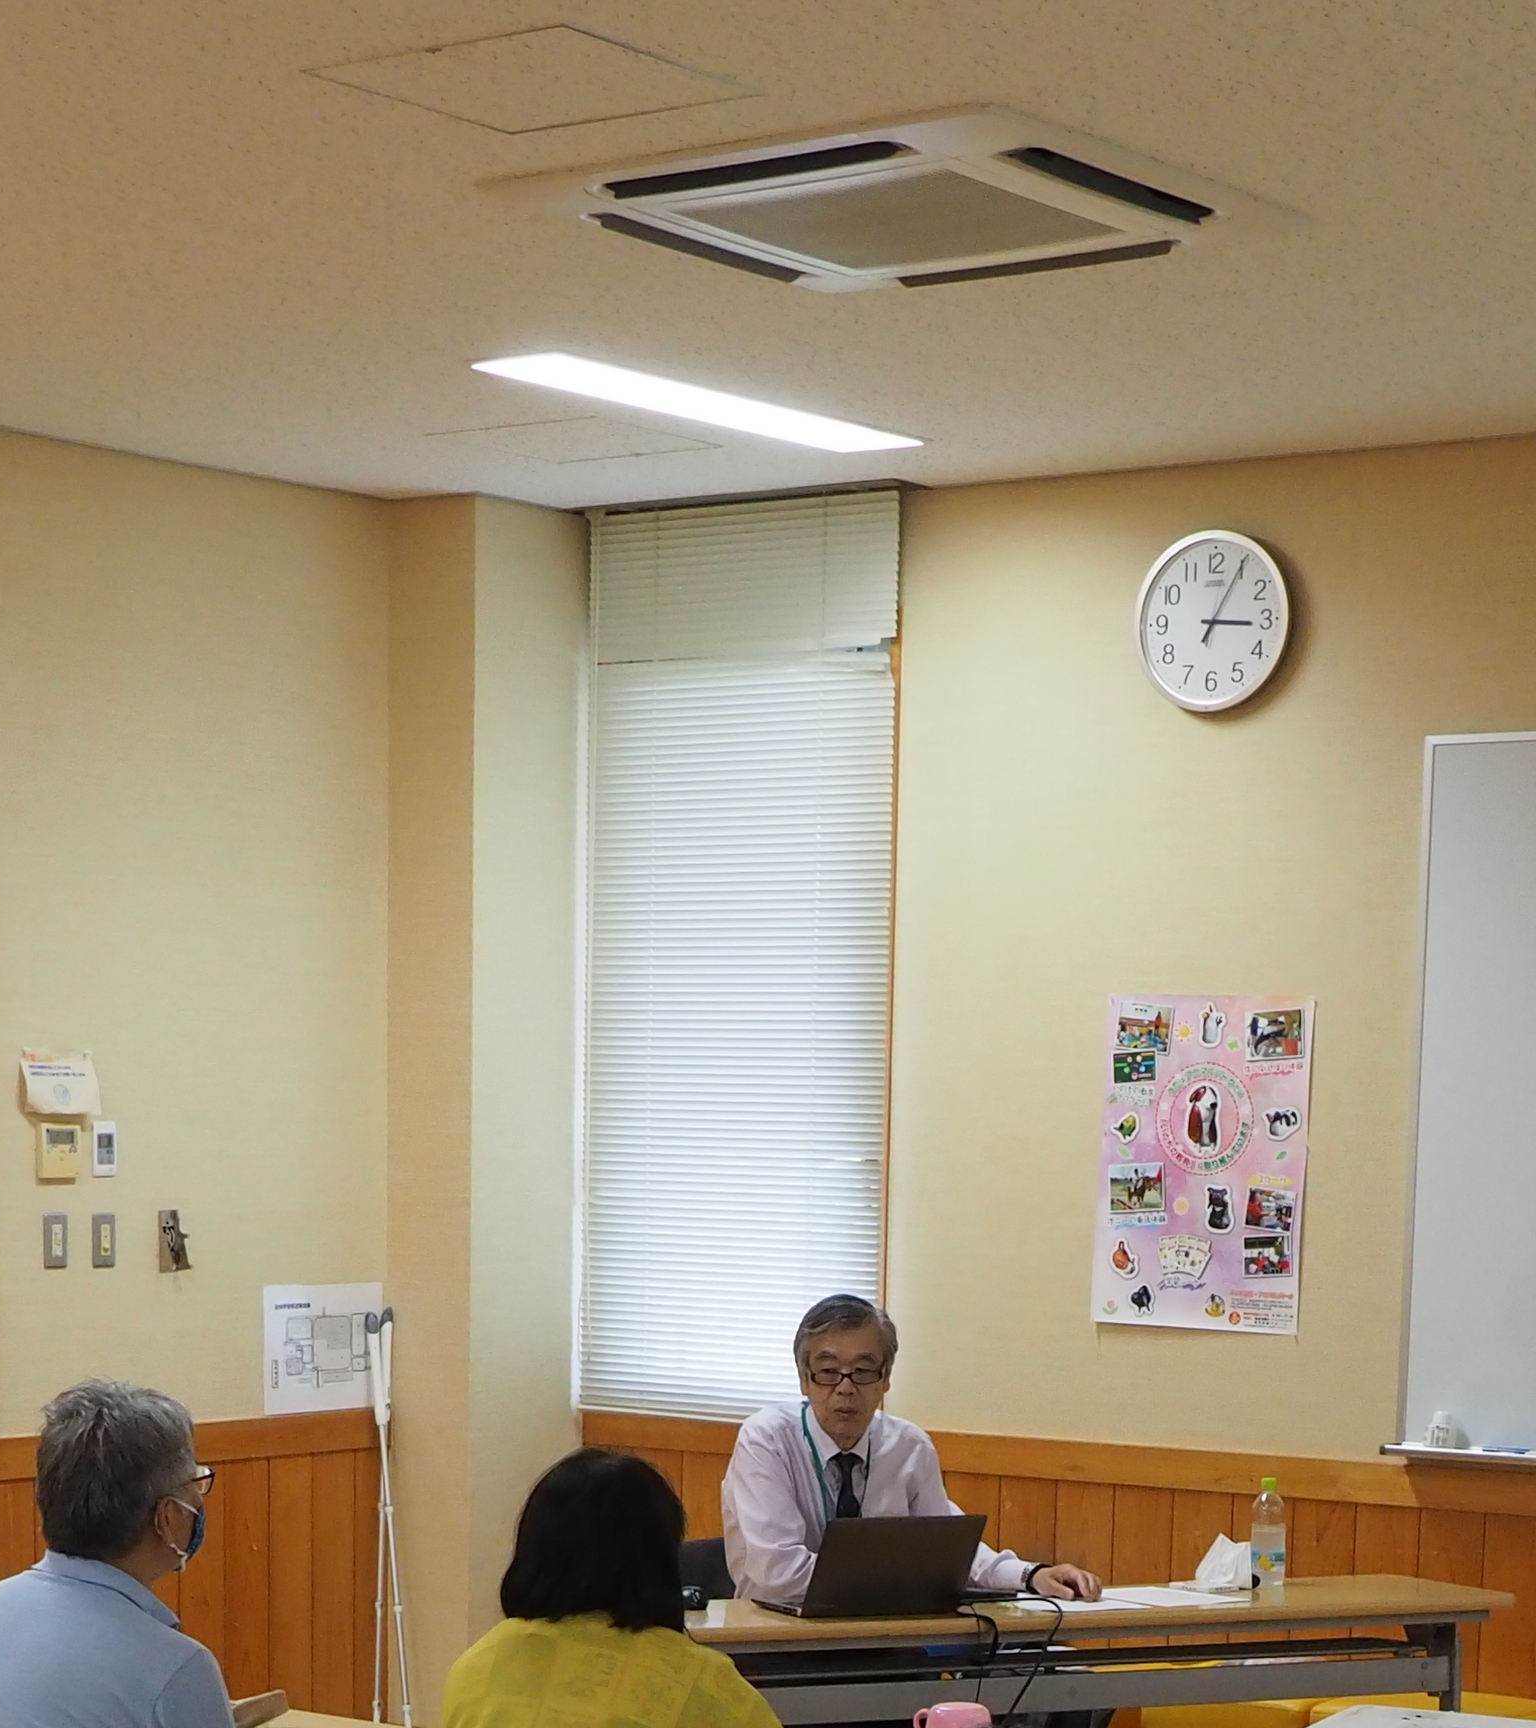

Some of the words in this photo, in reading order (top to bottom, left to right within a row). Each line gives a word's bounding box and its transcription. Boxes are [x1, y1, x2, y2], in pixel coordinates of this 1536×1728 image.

[1184, 562, 1197, 582] 11
[1208, 552, 1225, 574] 12
[1164, 584, 1181, 605] 10
[1253, 579, 1267, 601] 2
[1155, 614, 1169, 635] 9
[1259, 608, 1273, 630] 3
[1162, 643, 1175, 664] 8
[1250, 640, 1264, 660] 4
[1182, 665, 1194, 685] 7
[1204, 671, 1218, 692] 6
[1230, 662, 1244, 683] 5
